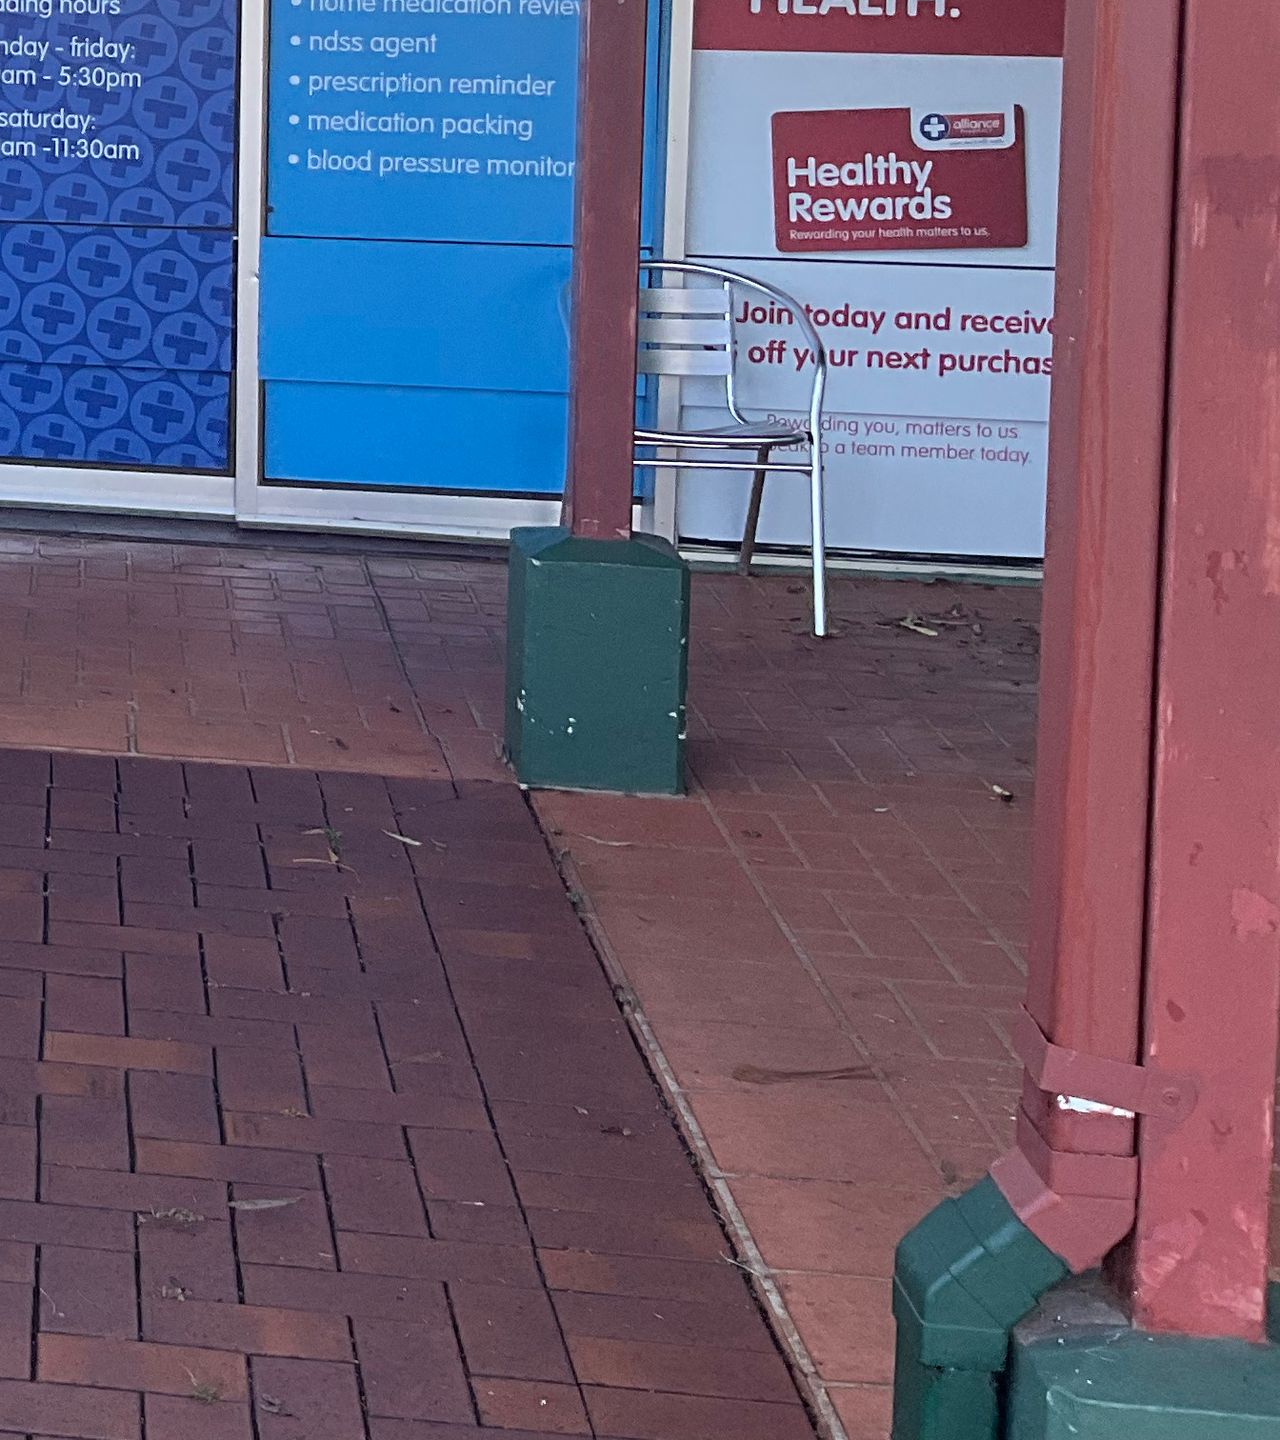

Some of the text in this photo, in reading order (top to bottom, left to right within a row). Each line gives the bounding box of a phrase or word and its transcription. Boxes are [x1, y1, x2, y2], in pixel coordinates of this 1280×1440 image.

[70, 36, 137, 64] friday:
[309, 30, 438, 58] ndss agent
[58, 66, 142, 92] 5:30pm
[308, 74, 556, 99] prescription reminder
[308, 110, 533, 141] medication packing
[953, 117, 1000, 130] alliance
[307, 149, 372, 172] blood
[379, 156, 480, 182] pressure
[788, 152, 933, 193] Healthy
[789, 186, 953, 223] Rewards
[790, 228, 849, 242] Rewarding
[851, 228, 876, 241] your
[878, 227, 913, 239] health
[916, 227, 959, 239] matters
[960, 227, 972, 237] to
[735, 300, 794, 325] Join
[804, 302, 886, 334] today
[894, 307, 951, 331] and
[747, 339, 787, 364] off
[793, 346, 859, 372] yur
[866, 348, 931, 371] next
[767, 414, 858, 436] Rewading
[863, 421, 900, 436] you,
[906, 422, 971, 438] matters
[976, 423, 993, 438] to
[835, 443, 845, 454] a
[851, 441, 896, 457] team
[901, 444, 974, 460] member
